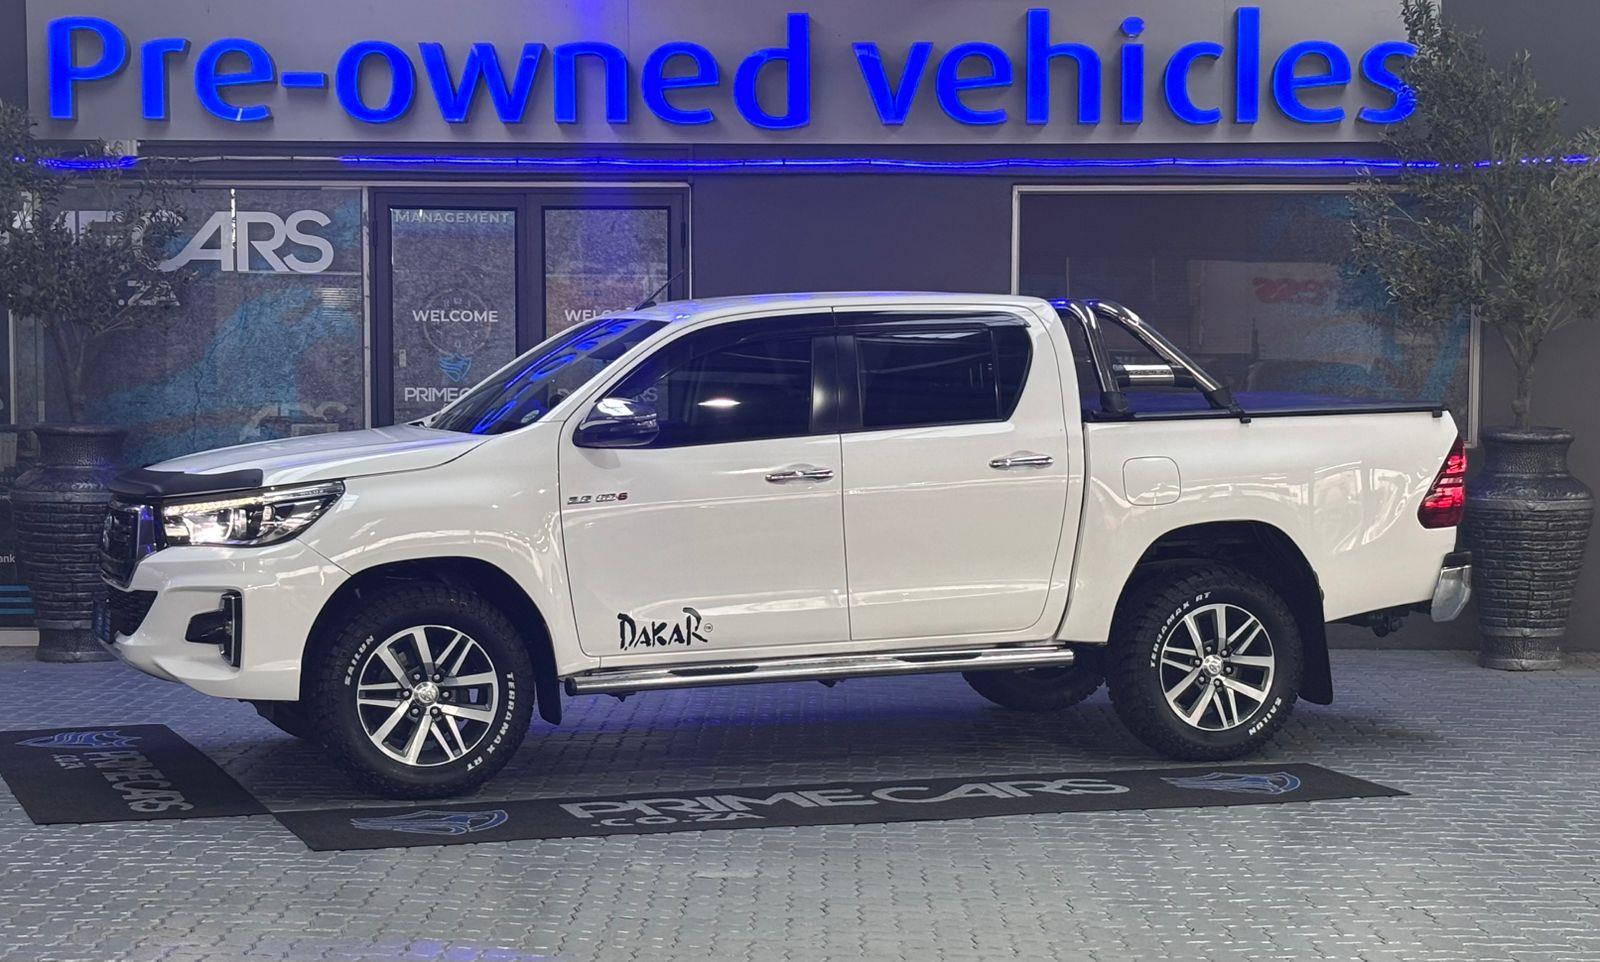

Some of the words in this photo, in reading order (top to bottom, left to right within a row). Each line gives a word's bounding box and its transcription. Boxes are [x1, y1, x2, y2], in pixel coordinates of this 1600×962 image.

[48, 13, 811, 127] Pre-owned
[852, 7, 1420, 126] vehicles
[394, 211, 509, 223] MANAGEMENT
[412, 310, 498, 322] WELCOME
[617, 607, 708, 651] DAKAR
[344, 634, 375, 686] SAILUN
[486, 671, 516, 754] TERRAMAX
[1248, 697, 1282, 736] SAILUN
